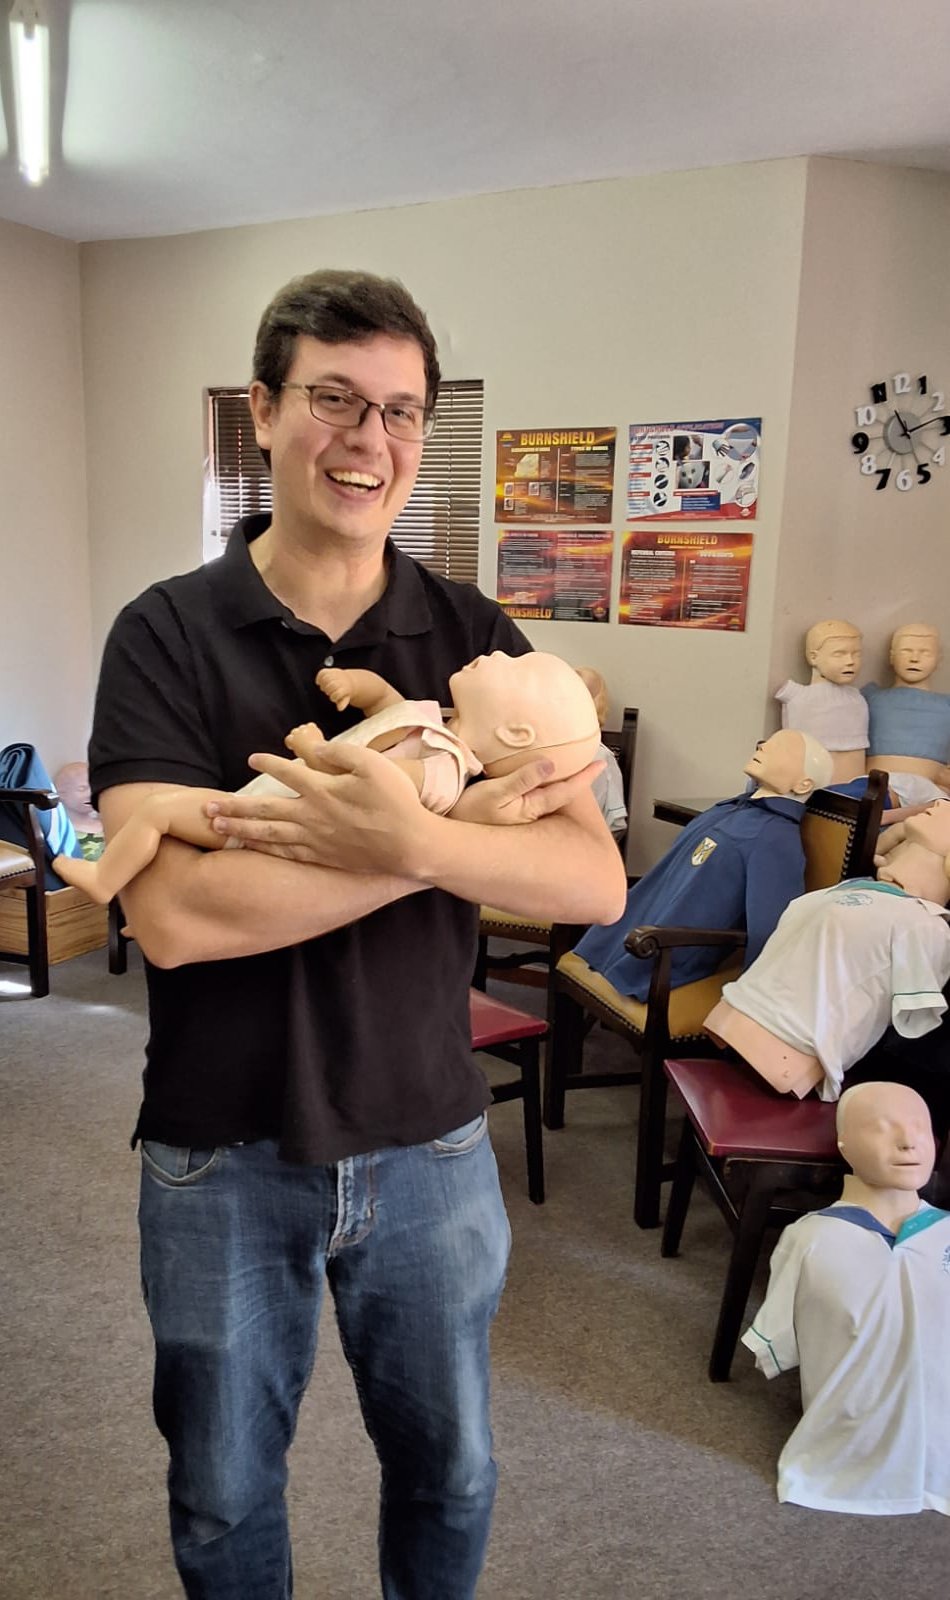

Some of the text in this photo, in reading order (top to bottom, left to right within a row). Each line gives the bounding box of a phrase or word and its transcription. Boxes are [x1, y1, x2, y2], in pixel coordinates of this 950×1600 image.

[895, 373, 911, 394] 12
[918, 375, 927, 395] 1
[932, 391, 945, 412] 2
[856, 406, 876, 426] 10
[520, 431, 596, 446] BURNSHIELD
[852, 432, 869, 454] 9
[861, 455, 876, 475] 8
[933, 447, 945, 466] 4
[875, 468, 892, 490] 7
[897, 469, 913, 492] 6
[917, 463, 931, 484] 5
[656, 534, 719, 545] BURNSHIELD
[503, 607, 553, 619] URNSHIELD
